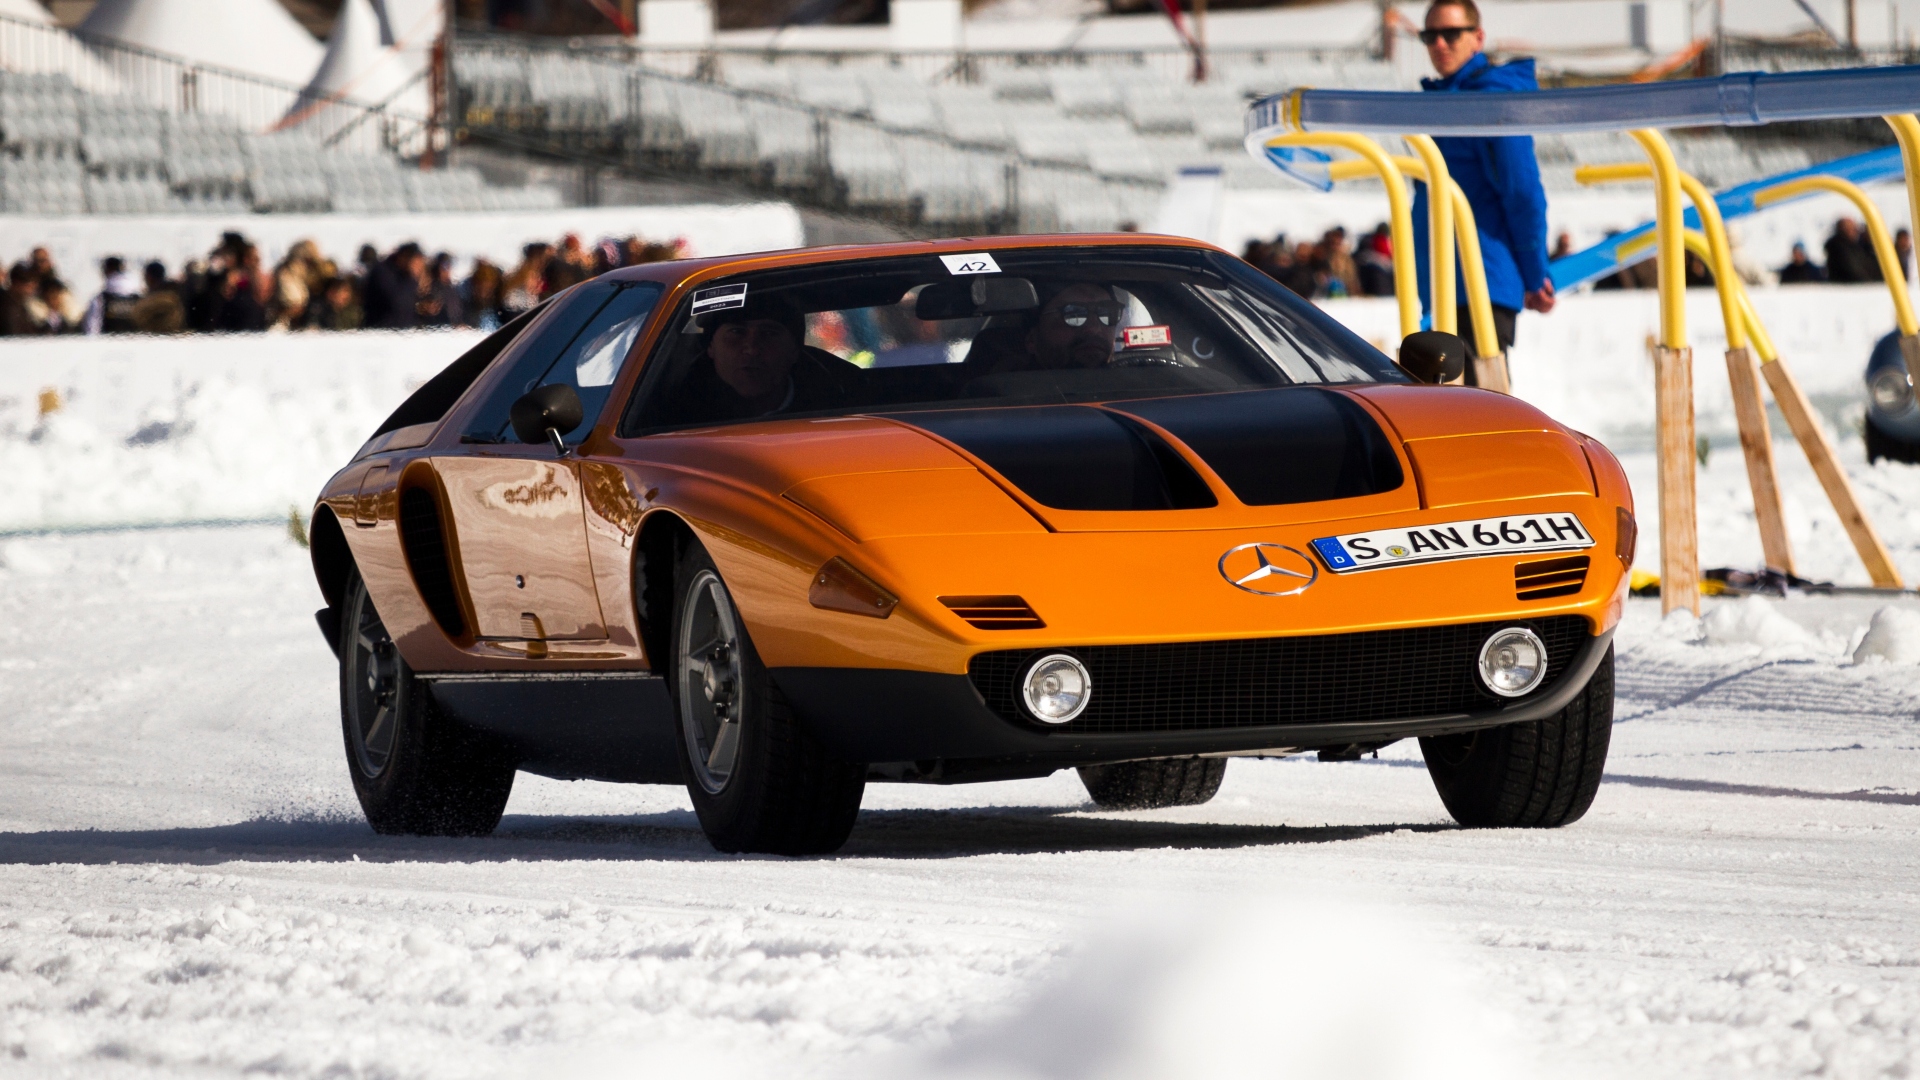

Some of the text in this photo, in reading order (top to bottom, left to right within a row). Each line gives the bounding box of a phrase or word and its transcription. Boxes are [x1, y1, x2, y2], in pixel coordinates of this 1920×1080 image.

[958, 261, 991, 272] 42
[1347, 516, 1586, 560] S AN 661H
[1333, 556, 1345, 564] D
